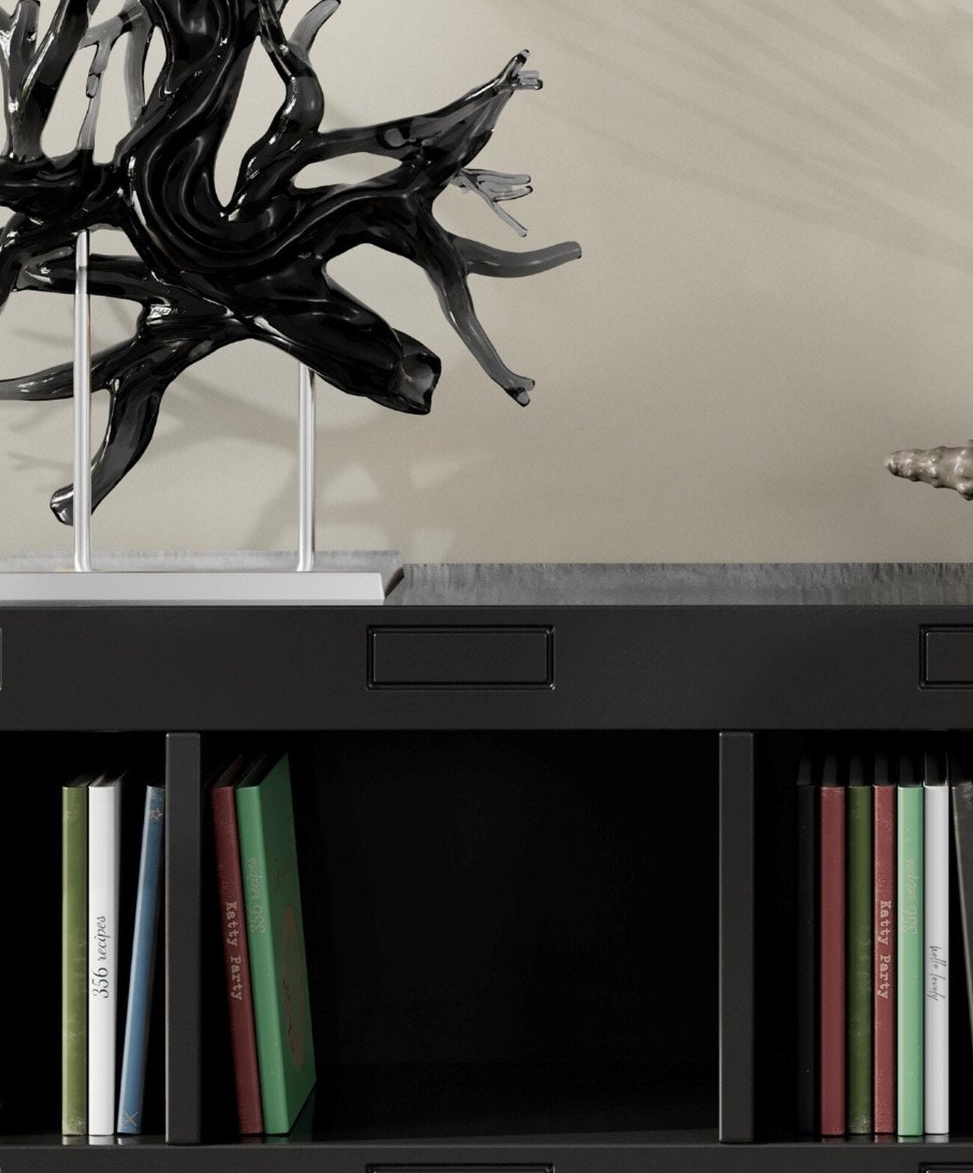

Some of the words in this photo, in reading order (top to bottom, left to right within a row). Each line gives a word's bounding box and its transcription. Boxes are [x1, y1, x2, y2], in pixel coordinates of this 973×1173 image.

[94, 915, 111, 961] recipes
[226, 901, 239, 947] Katty
[877, 900, 891, 945] Katty
[92, 967, 109, 999] 356
[231, 956, 243, 1001] Party
[877, 955, 891, 999] Party
